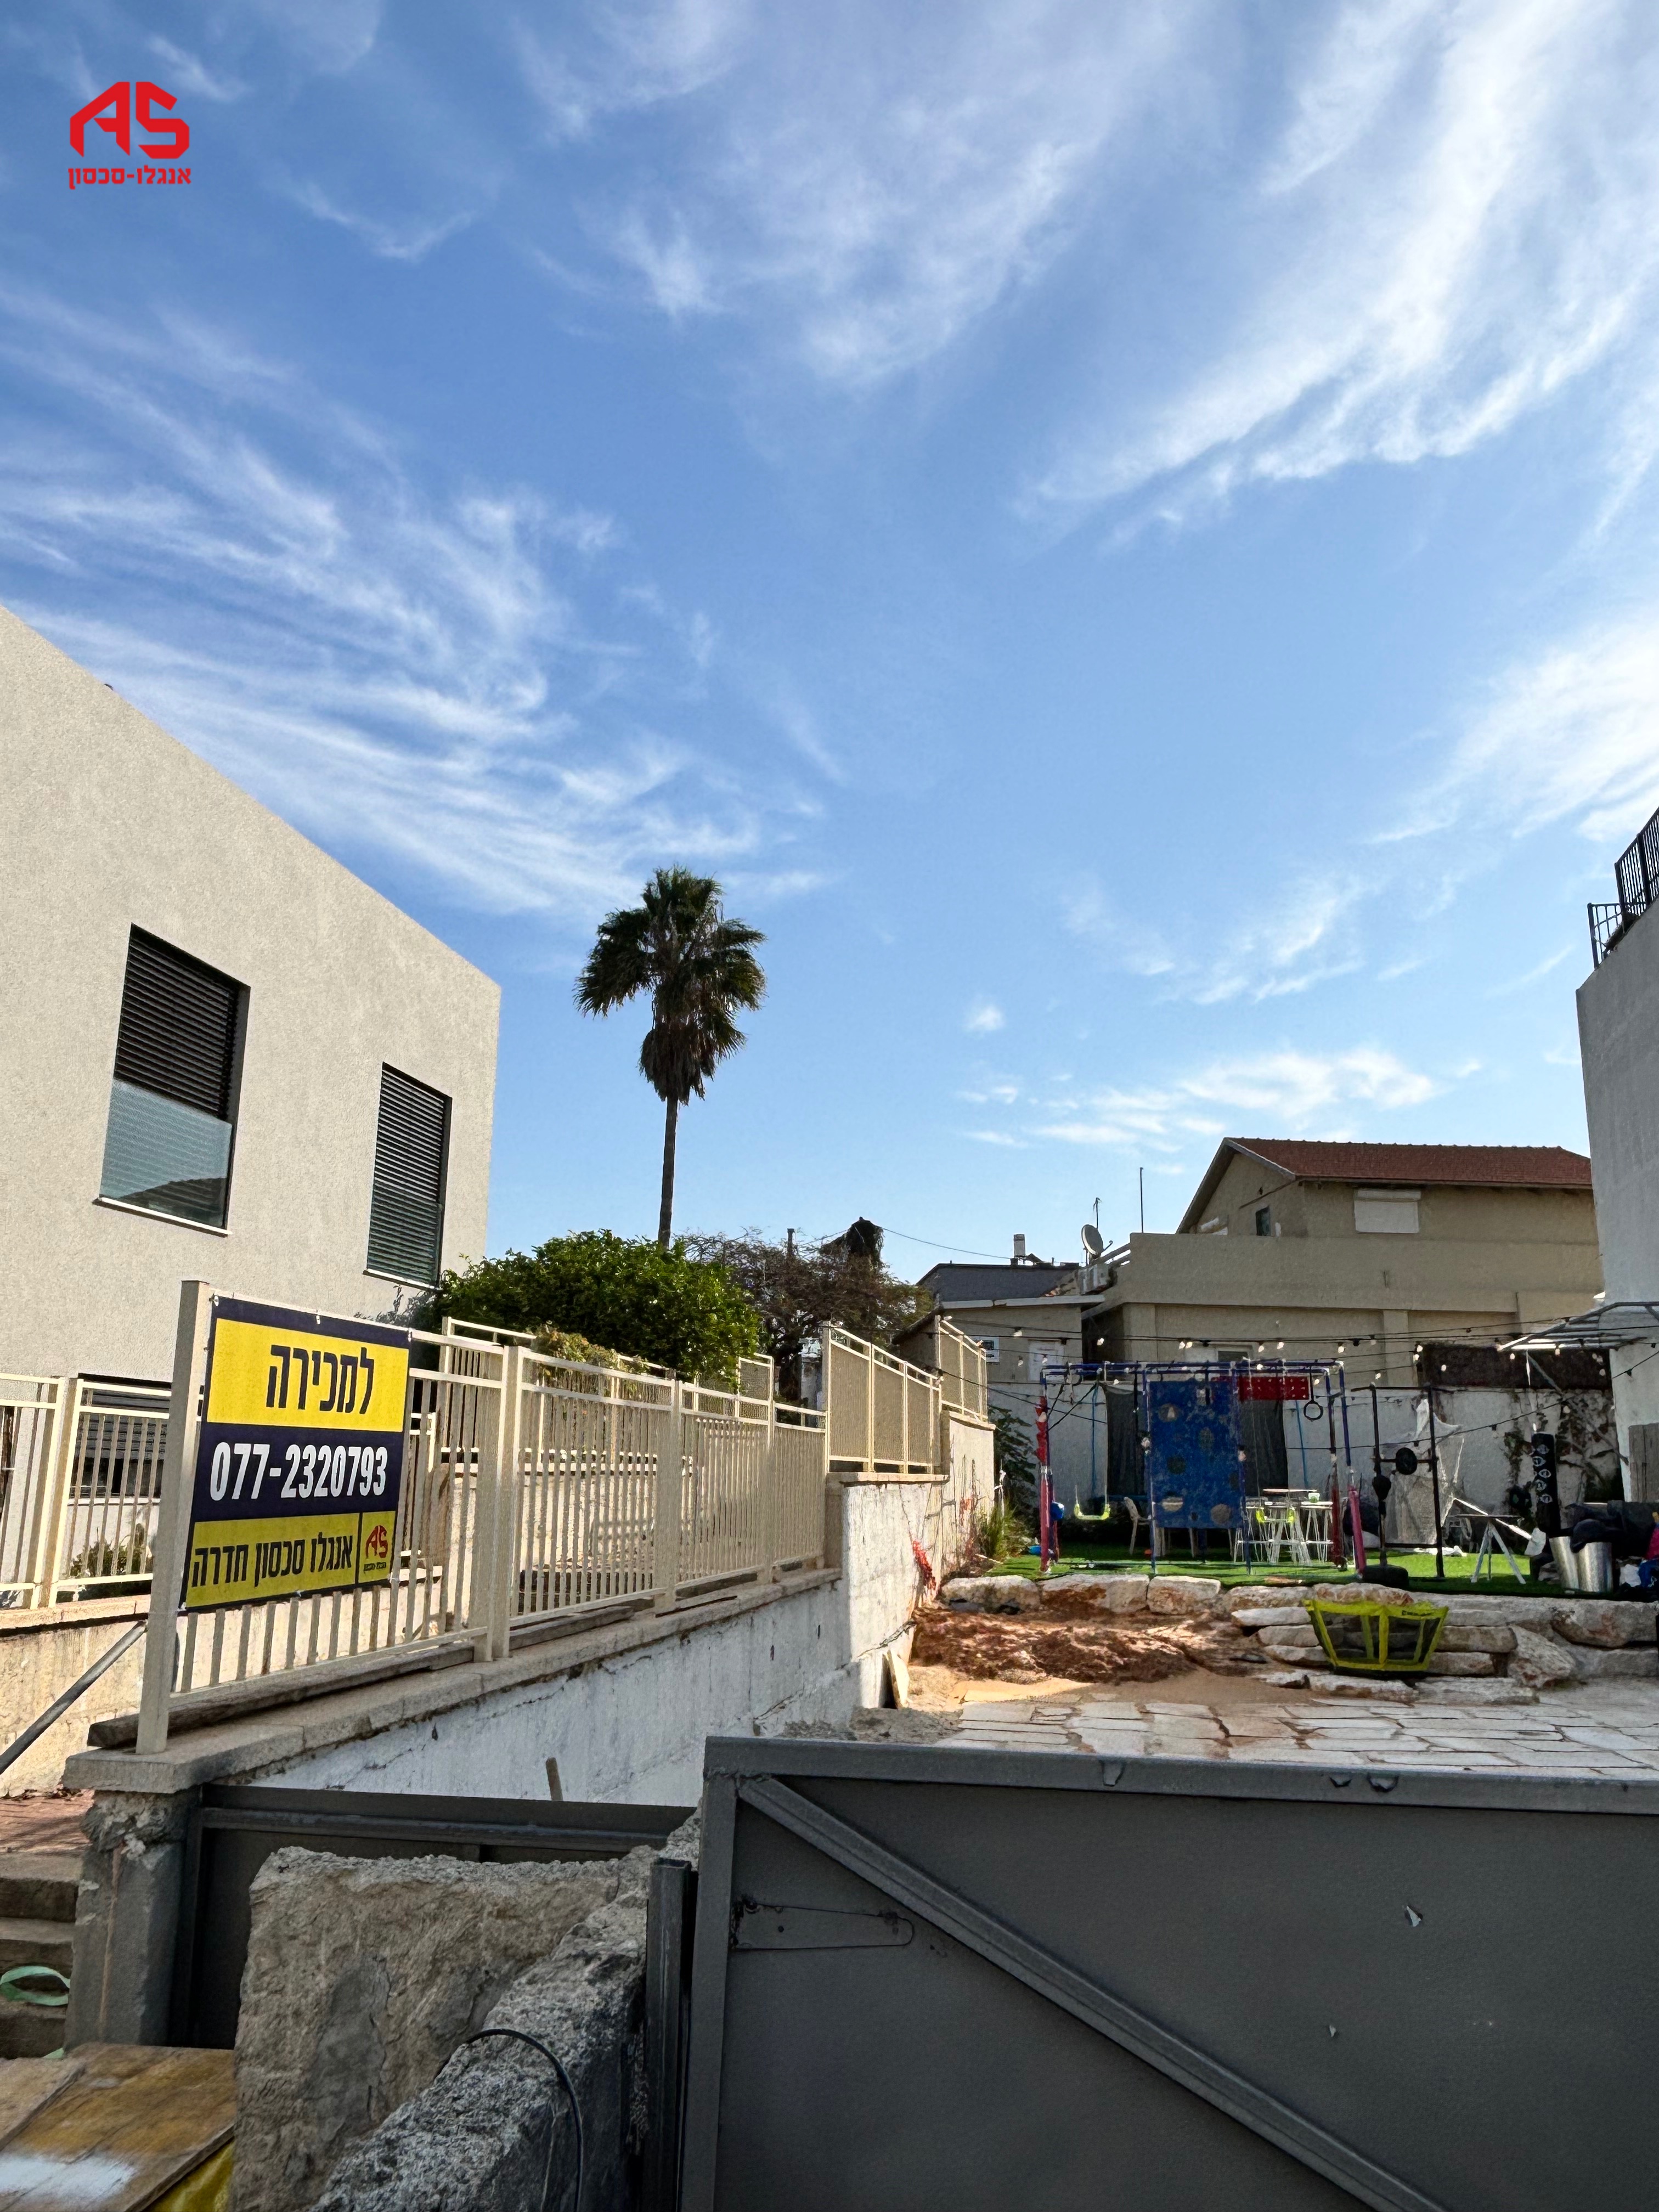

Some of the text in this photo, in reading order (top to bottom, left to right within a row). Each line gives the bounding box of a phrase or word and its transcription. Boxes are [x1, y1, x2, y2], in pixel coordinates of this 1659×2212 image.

[266, 1344, 375, 1414] למכירה
[210, 1442, 388, 1501] 077-2320793
[192, 1532, 353, 1588] אנגלו סכסון חדרה
[365, 1525, 388, 1559] AS
